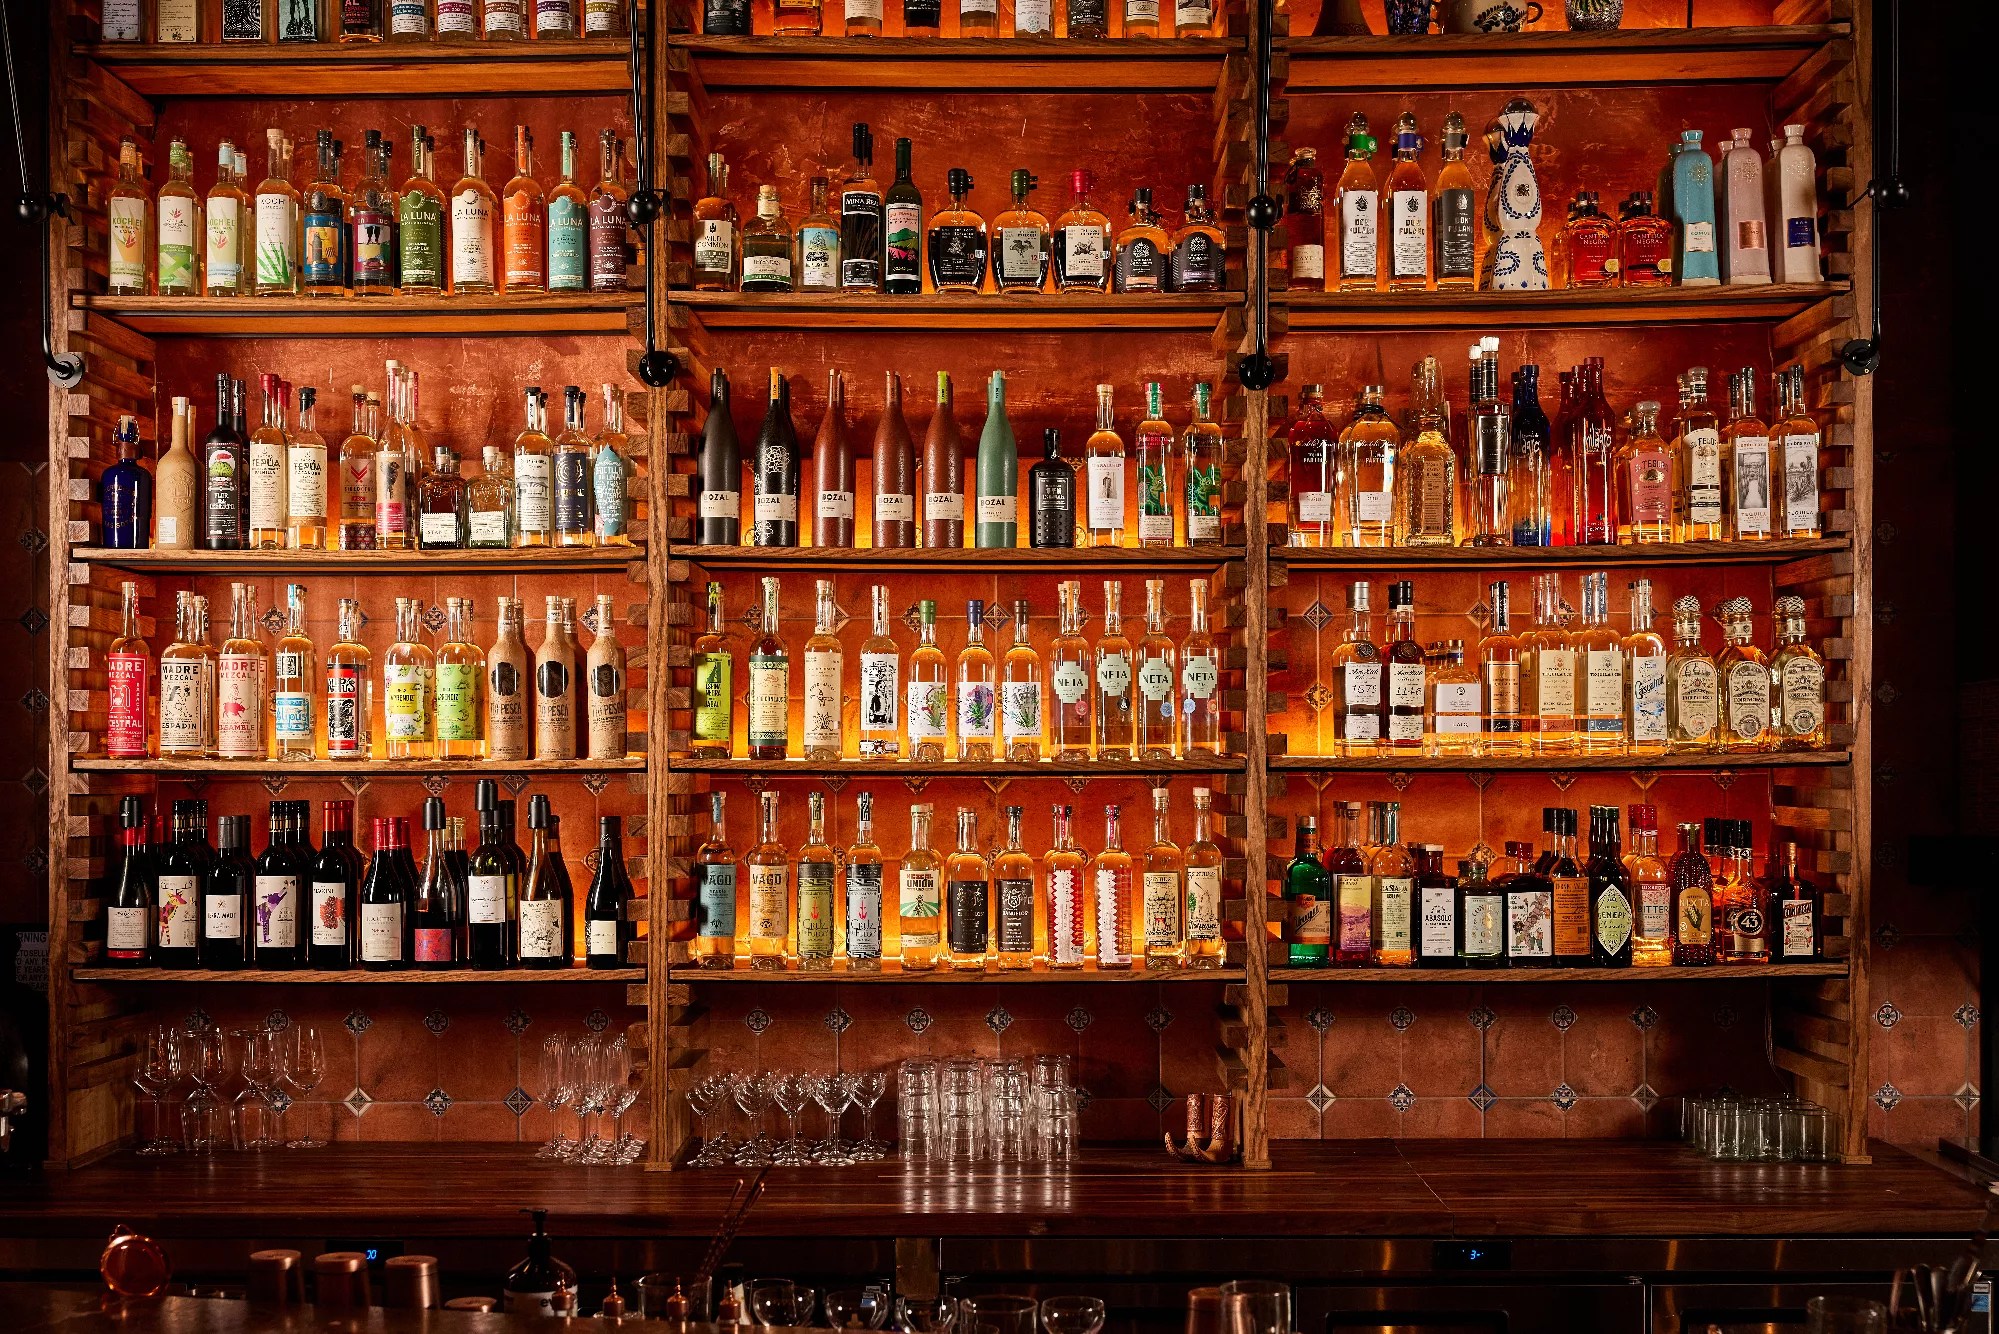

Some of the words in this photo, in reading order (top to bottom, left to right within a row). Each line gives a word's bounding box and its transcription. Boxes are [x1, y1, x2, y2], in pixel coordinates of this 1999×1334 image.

[400, 212, 409, 222] LA
[410, 211, 436, 222] LUNA
[455, 209, 463, 217] LA
[465, 208, 489, 217] LUNA
[504, 214, 514, 223] LA
[516, 212, 541, 223] LUNA
[113, 217, 132, 225] KOCH
[549, 219, 556, 228] LA
[558, 217, 583, 228] LUNA
[591, 215, 600, 226] LA
[602, 215, 627, 226] LUNA
[703, 493, 730, 501] BOZAL
[822, 493, 847, 501] BOZAL
[162, 665, 199, 675] MADRE
[1101, 670, 1128, 680] NETA
[1057, 678, 1084, 686] NETA
[1142, 675, 1169, 684] NETA
[1187, 672, 1215, 682] NETA
[703, 874, 732, 886] VAGO
[752, 873, 782, 885] VAGO
[906, 878, 934, 888] UNIÓN
[1679, 899, 1710, 907] NIXTA
[1637, 905, 1669, 914] BITTER
[1741, 916, 1759, 928] 43
